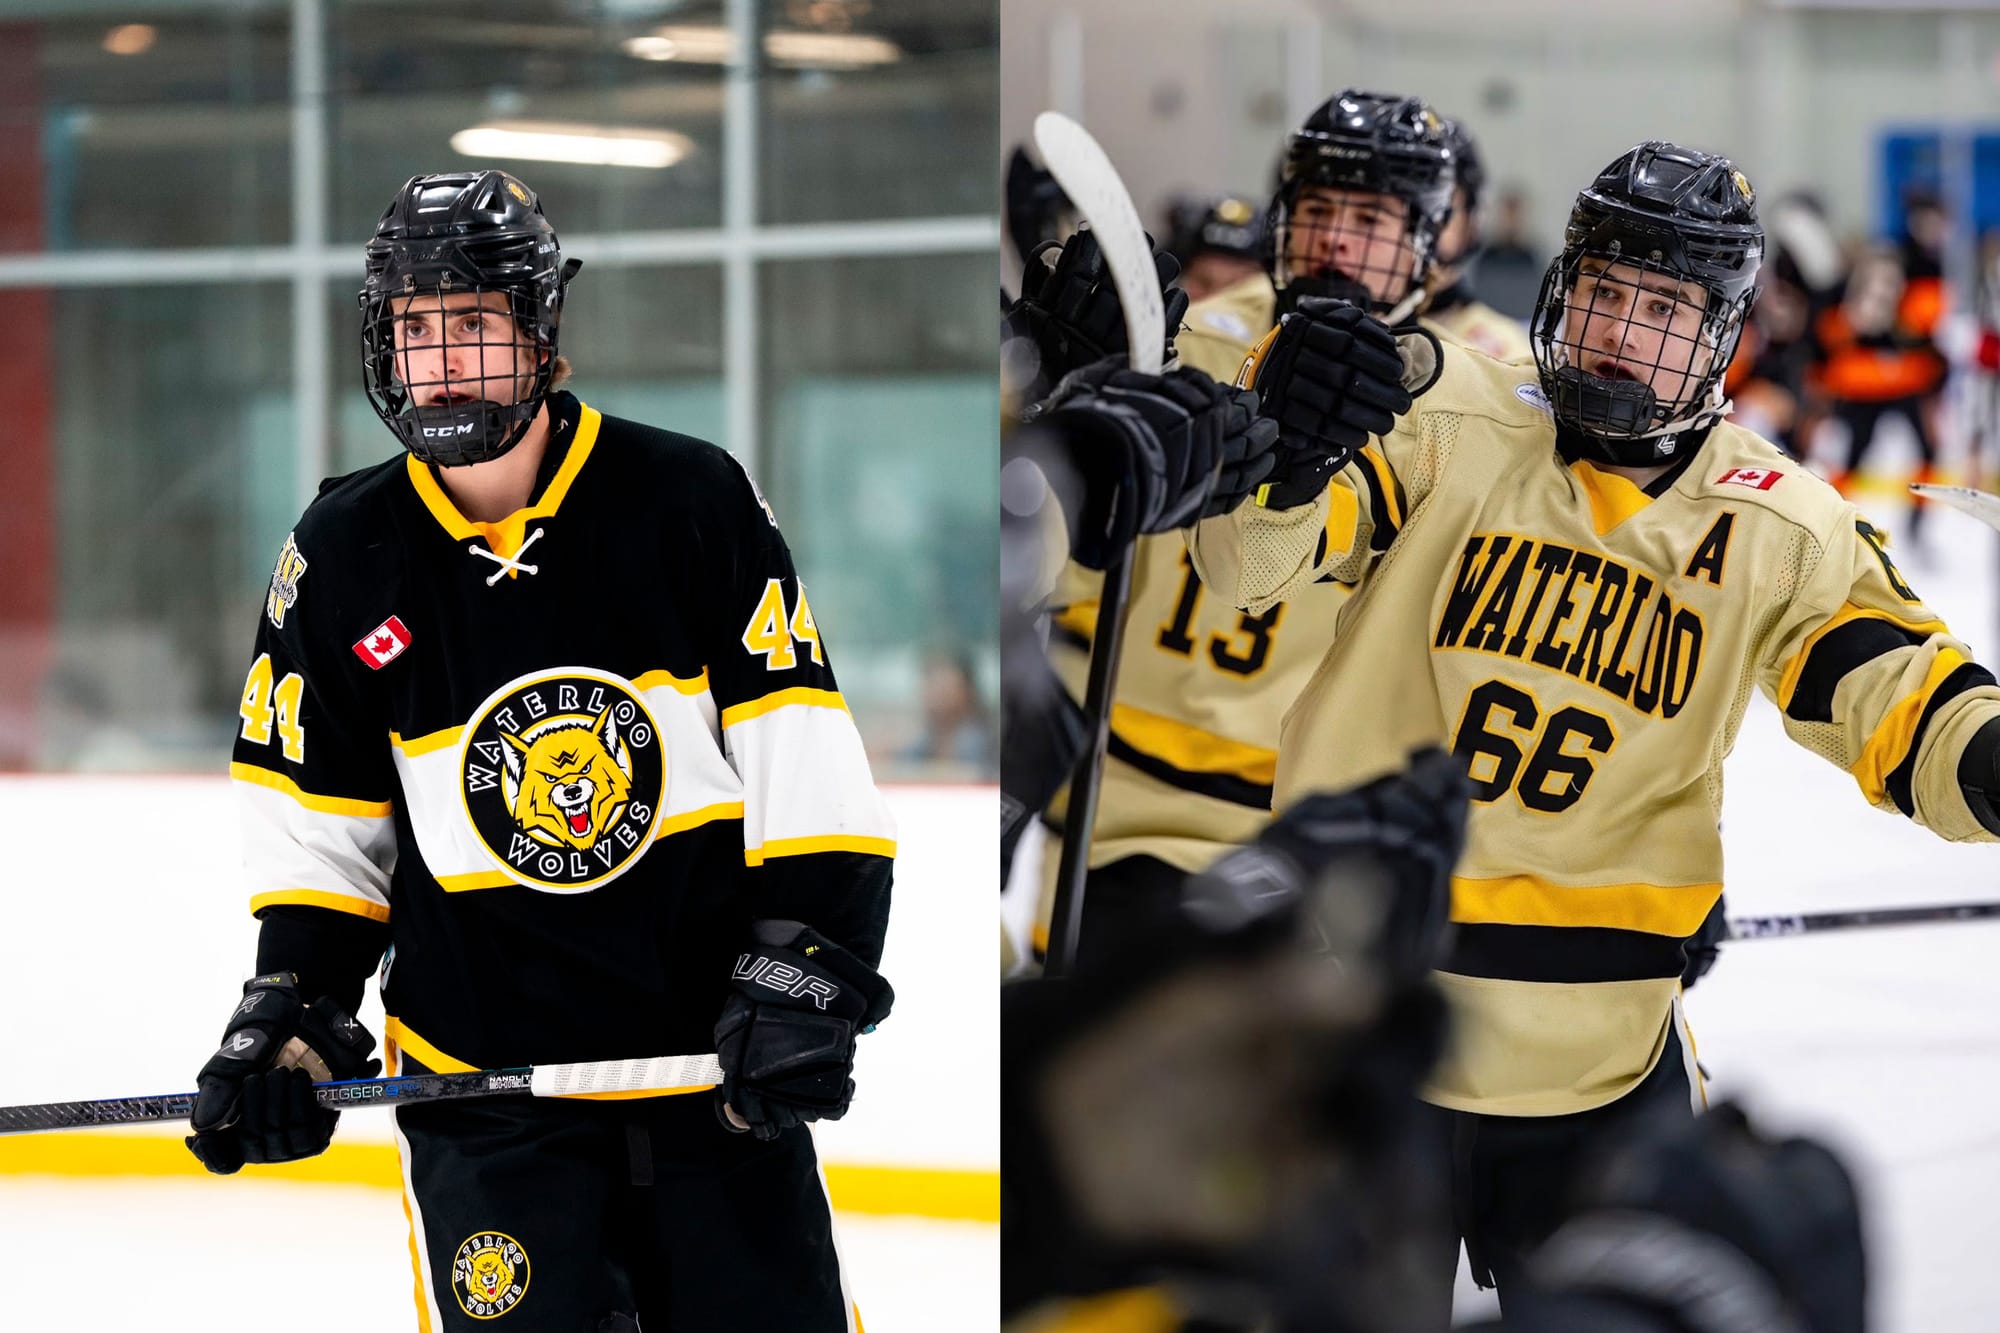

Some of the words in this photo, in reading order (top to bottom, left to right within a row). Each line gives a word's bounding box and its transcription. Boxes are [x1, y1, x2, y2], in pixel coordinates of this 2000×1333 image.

[422, 422, 475, 438] CCM
[1681, 508, 1737, 590] A
[741, 576, 825, 671] 44
[1156, 545, 1287, 682] 13
[1430, 530, 1707, 721] WATERLOO
[239, 652, 305, 765] 44
[466, 684, 652, 793] WATERLOO
[1451, 676, 1620, 817] 66
[507, 800, 651, 878] WOLVES
[731, 952, 841, 1011] UER
[314, 1084, 383, 1102] RIGGER
[489, 1074, 532, 1083] NANOLIT
[454, 1235, 524, 1283] WATERLOO
[466, 1284, 522, 1315] WOLVES
